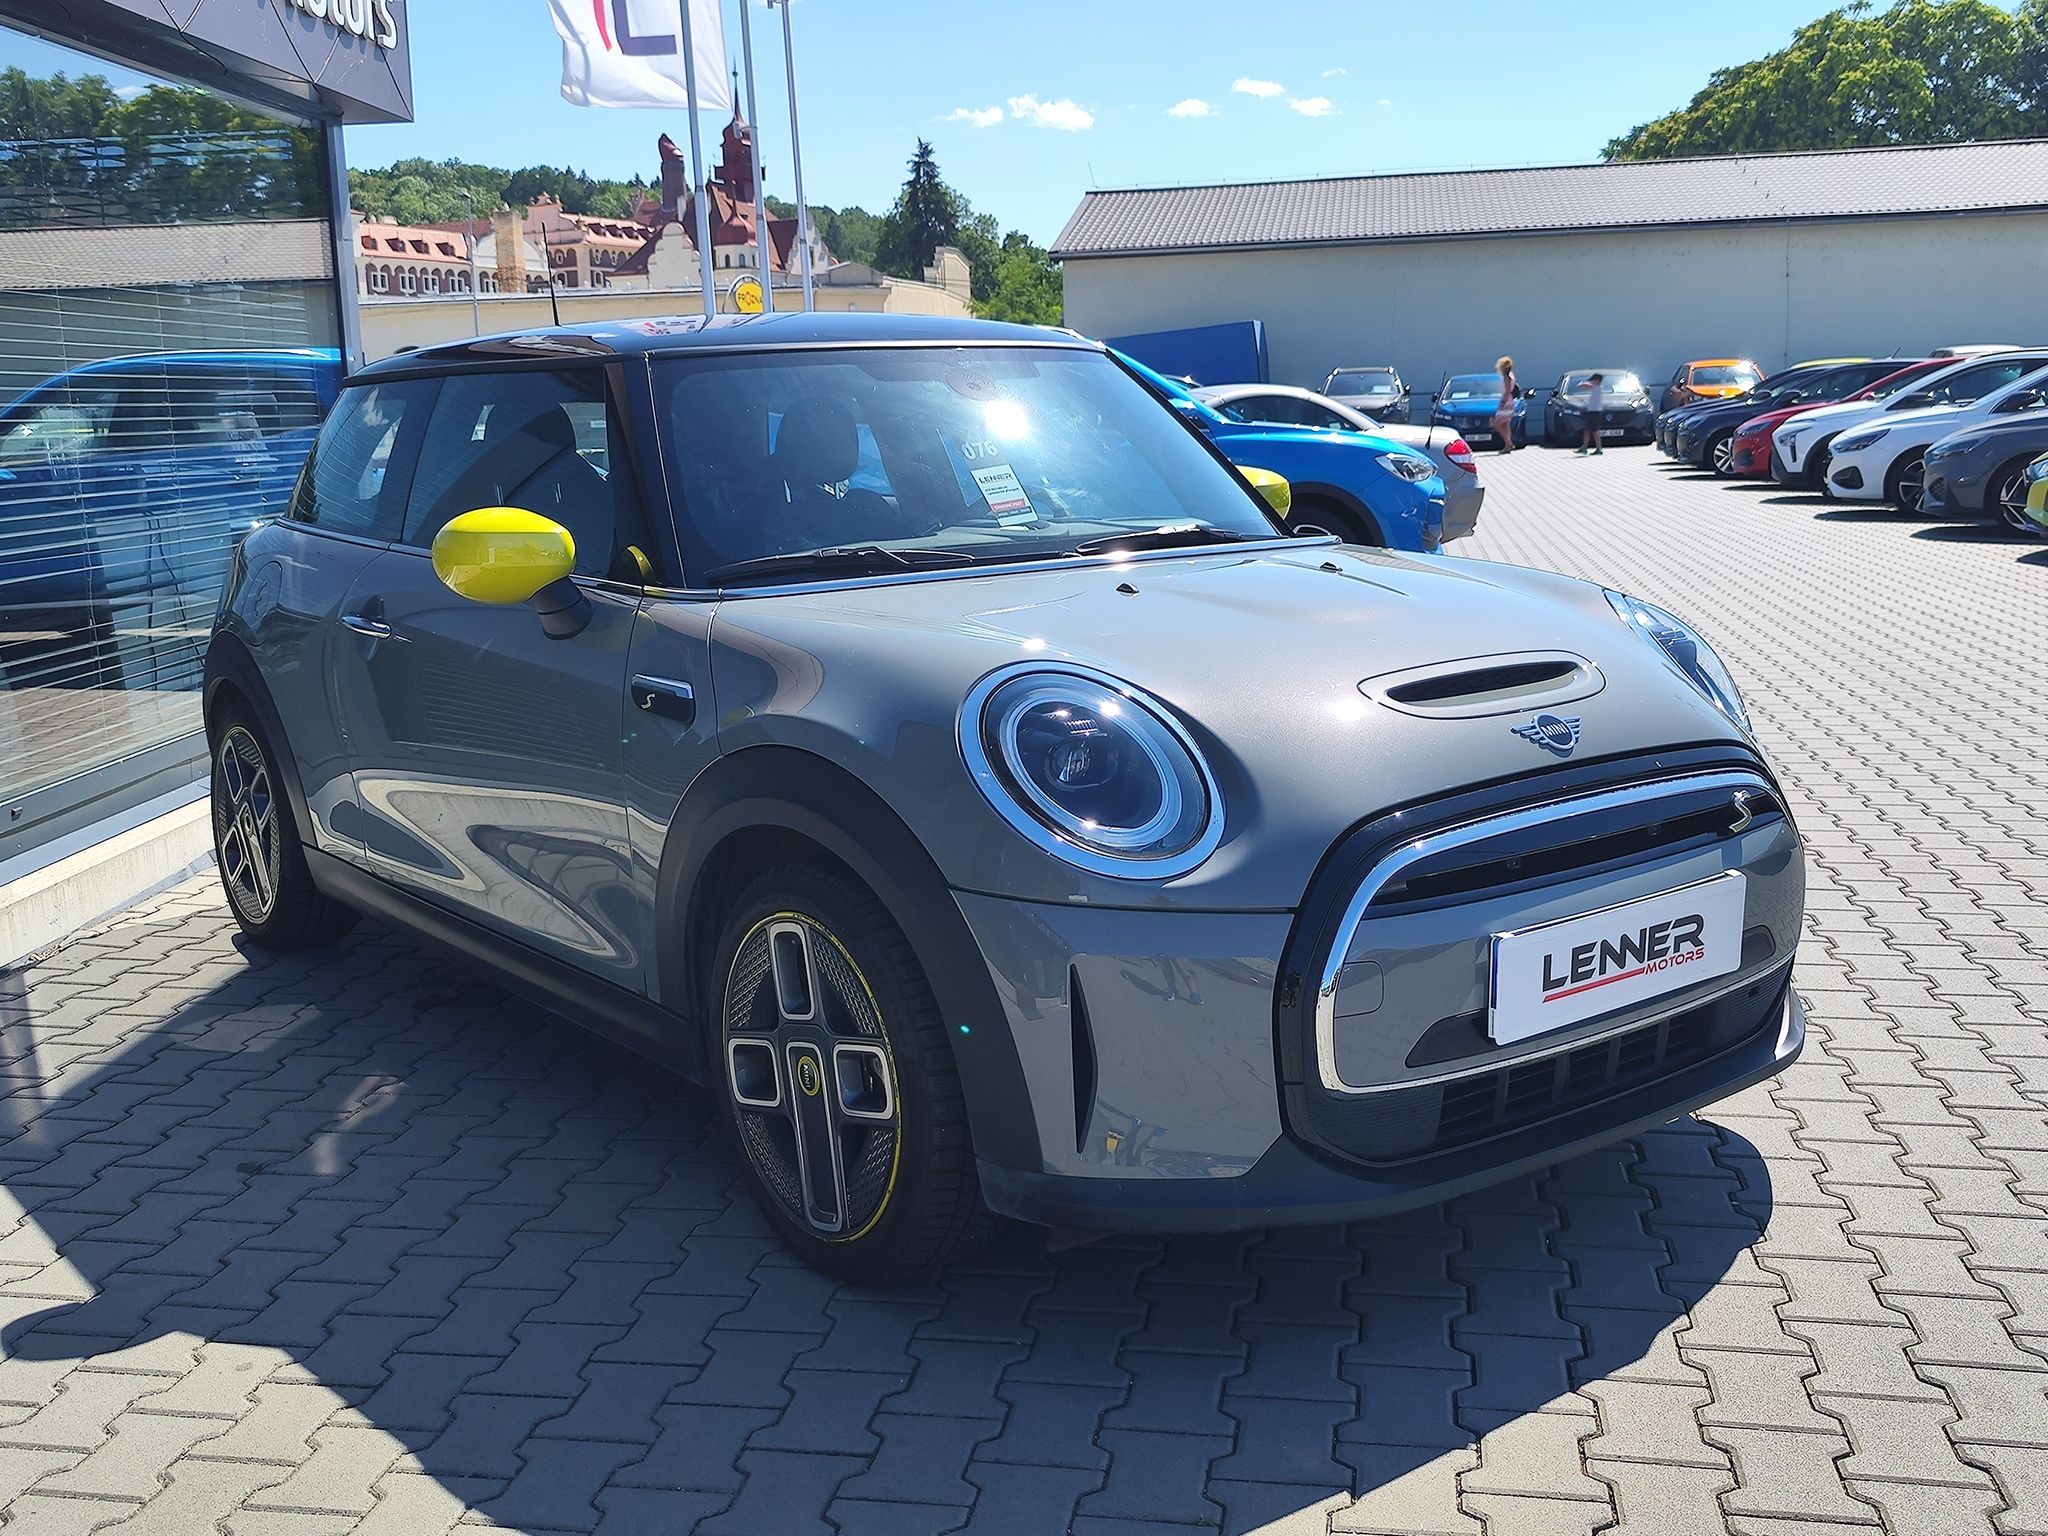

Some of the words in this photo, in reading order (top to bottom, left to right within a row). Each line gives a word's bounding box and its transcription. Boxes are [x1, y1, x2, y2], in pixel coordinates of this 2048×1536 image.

[961, 440, 999, 460] 076
[1541, 723, 1569, 737] MINI
[1542, 913, 1705, 993] LENNER
[1645, 947, 1705, 976] MOTORS
